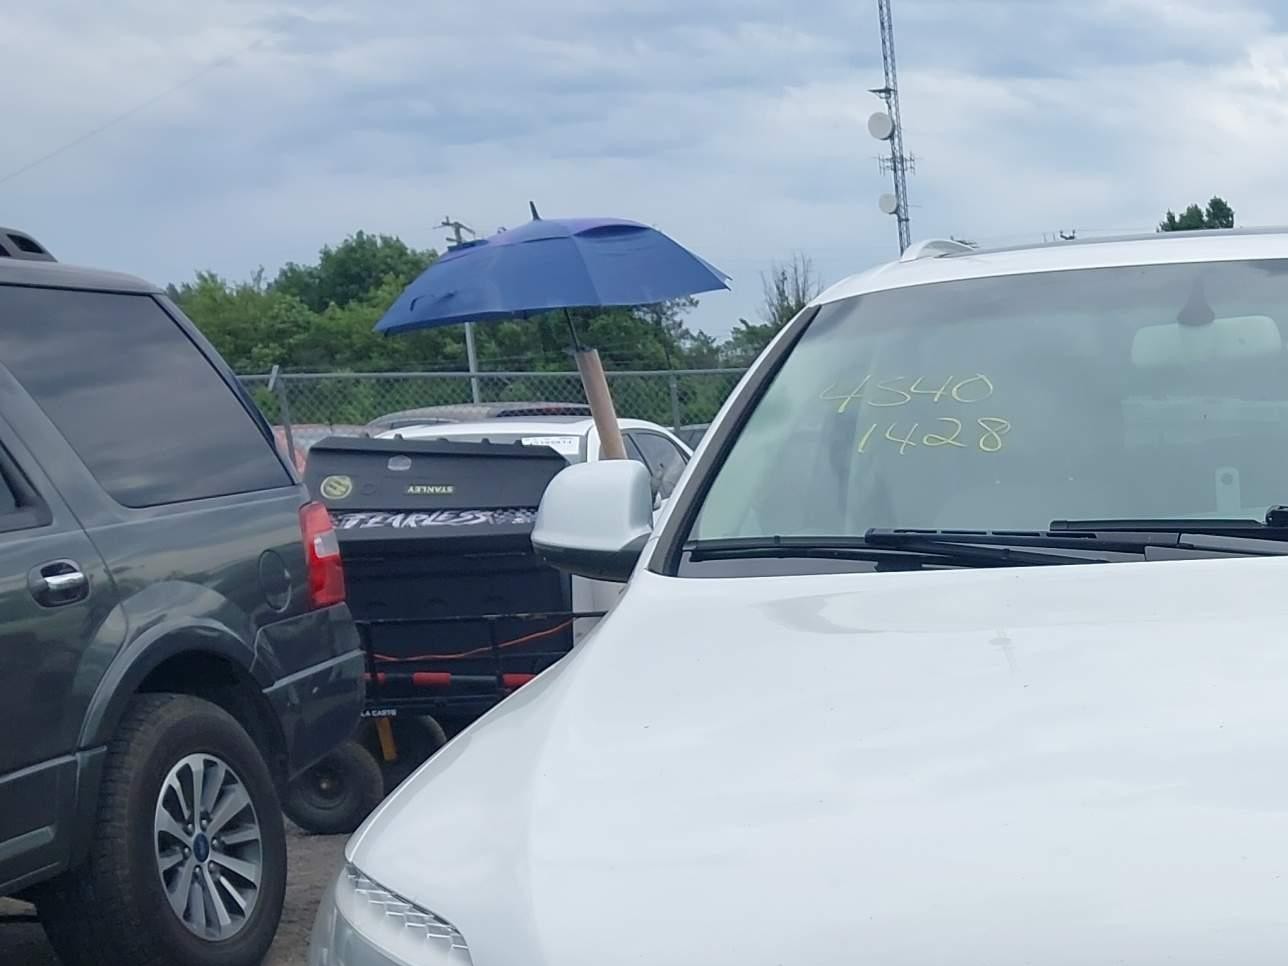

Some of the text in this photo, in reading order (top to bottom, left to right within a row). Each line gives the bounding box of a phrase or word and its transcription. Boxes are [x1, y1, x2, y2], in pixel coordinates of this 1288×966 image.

[819, 373, 993, 413] 4540
[858, 416, 1011, 455] 1428
[408, 485, 454, 494] STANLEY
